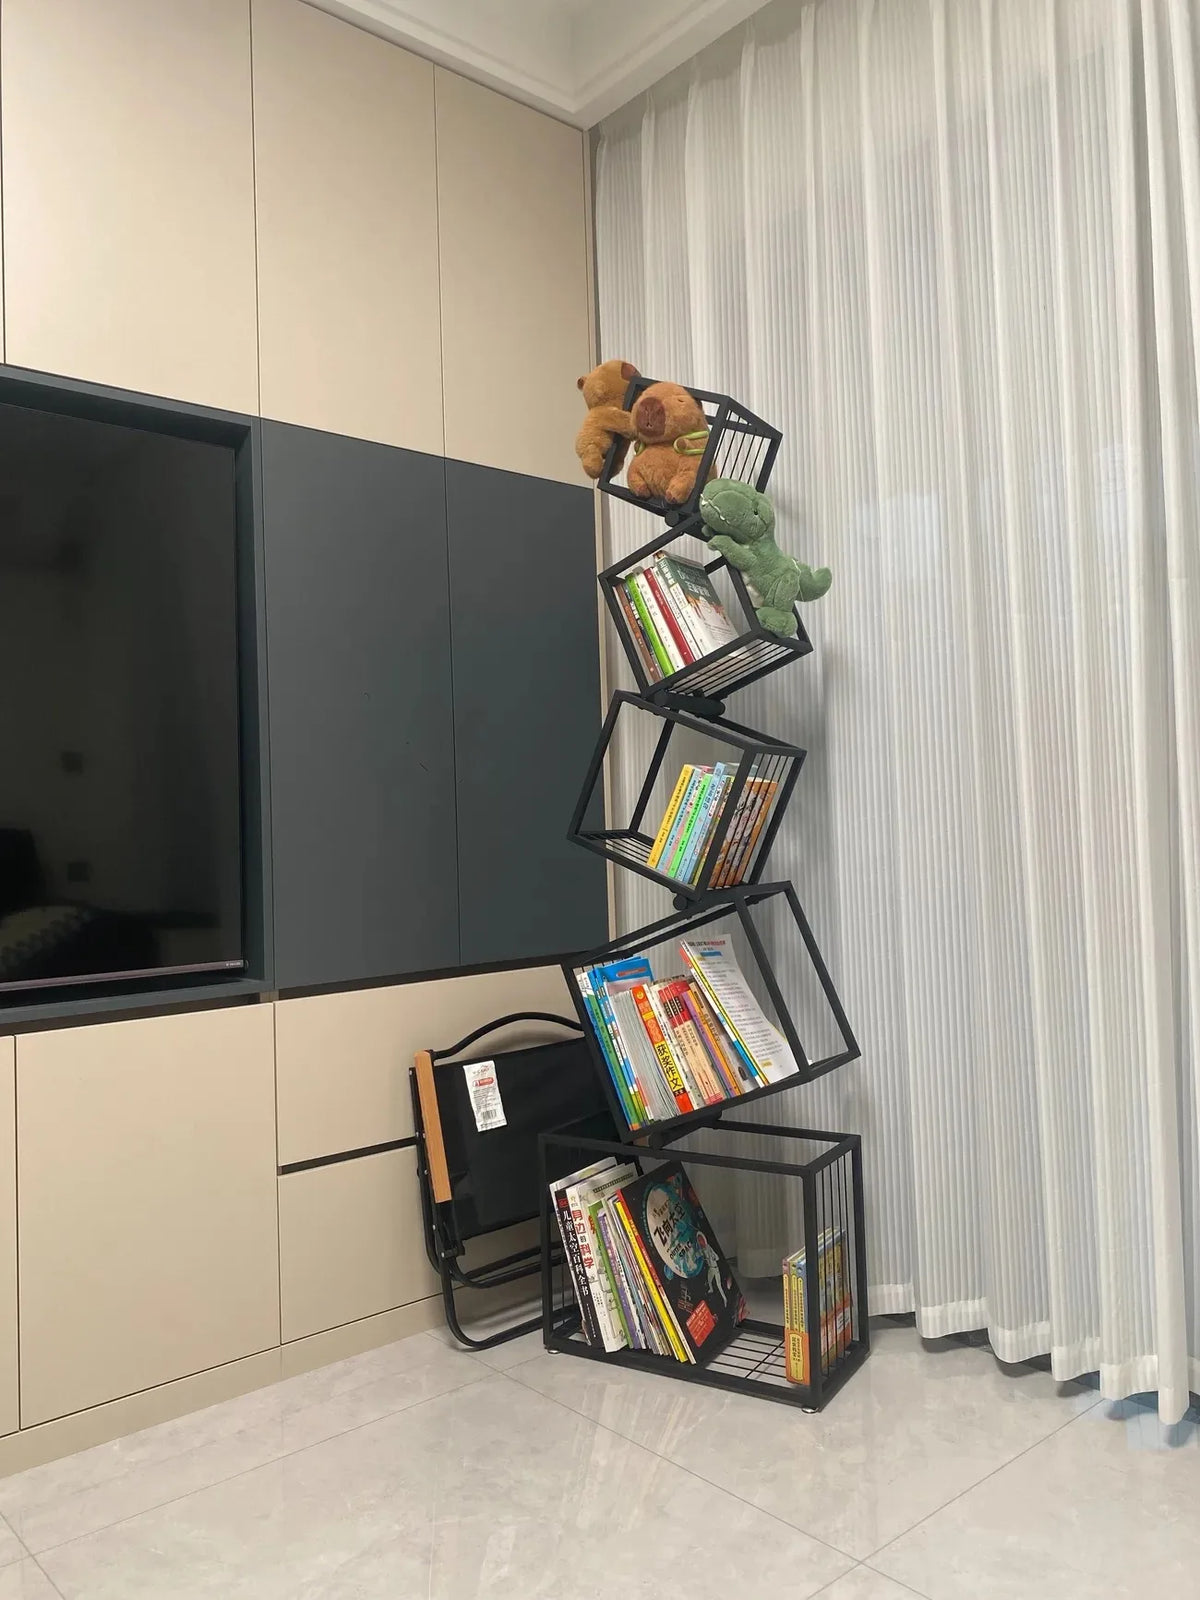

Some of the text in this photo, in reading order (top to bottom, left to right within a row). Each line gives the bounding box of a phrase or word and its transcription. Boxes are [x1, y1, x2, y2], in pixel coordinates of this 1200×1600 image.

[563, 1210, 589, 1297] 儿童太空百科全书
[653, 1201, 686, 1247] 飞向太空
